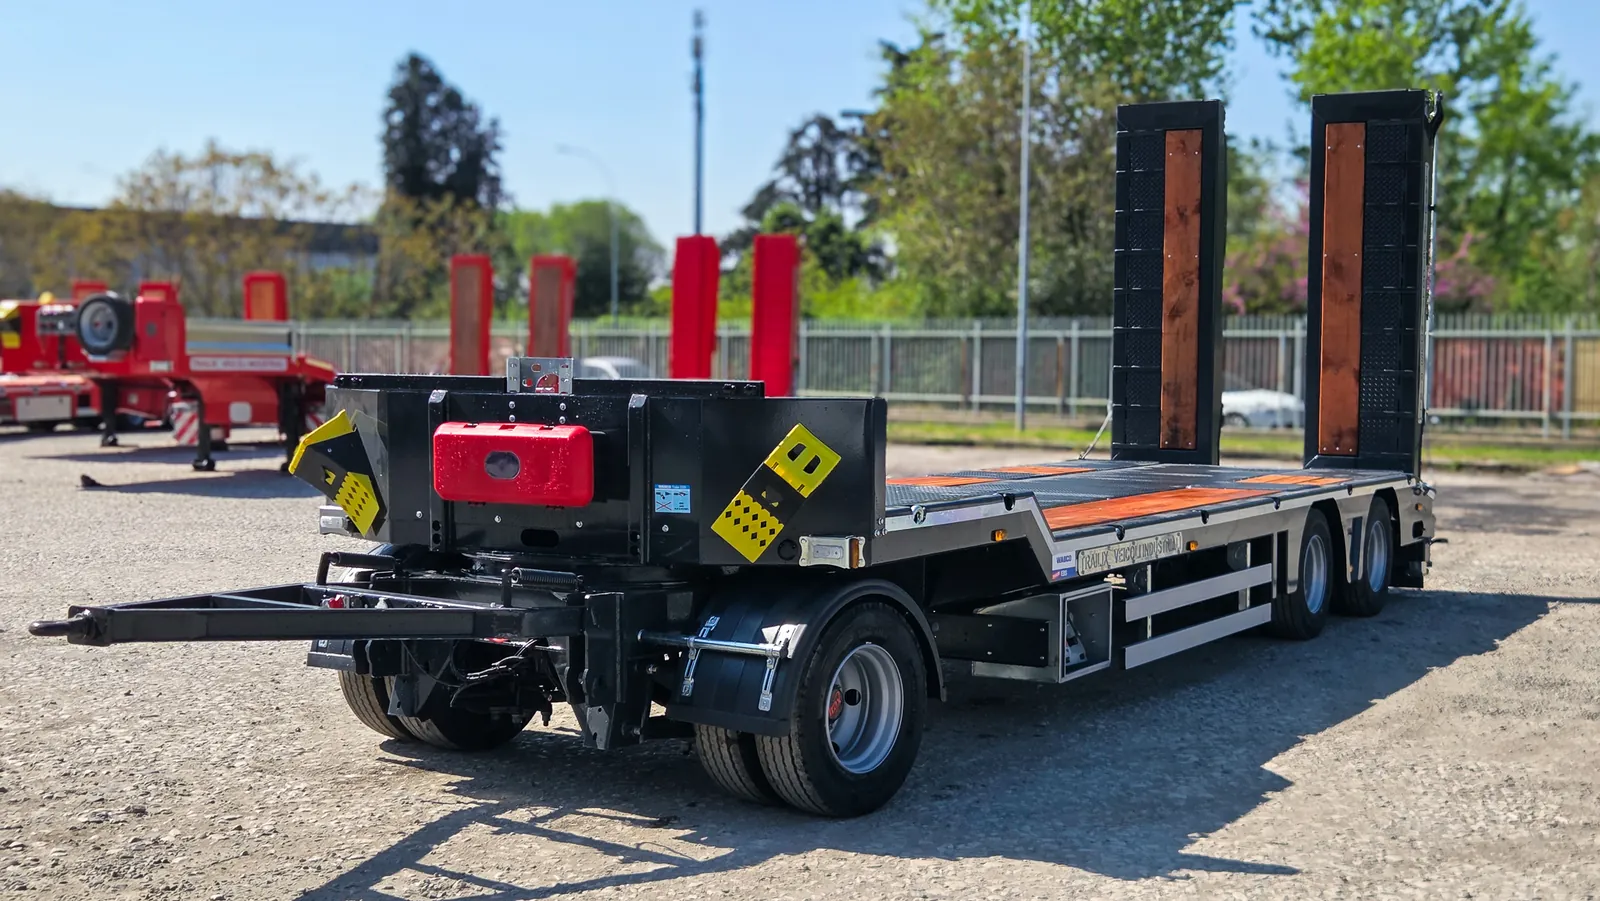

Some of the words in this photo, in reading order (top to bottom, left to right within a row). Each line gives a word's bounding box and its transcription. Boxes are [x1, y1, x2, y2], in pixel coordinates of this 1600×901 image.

[1056, 555, 1072, 563] WABCO
[1081, 550, 1110, 570] TRAILIX
[1113, 544, 1142, 563] VEICOLI
